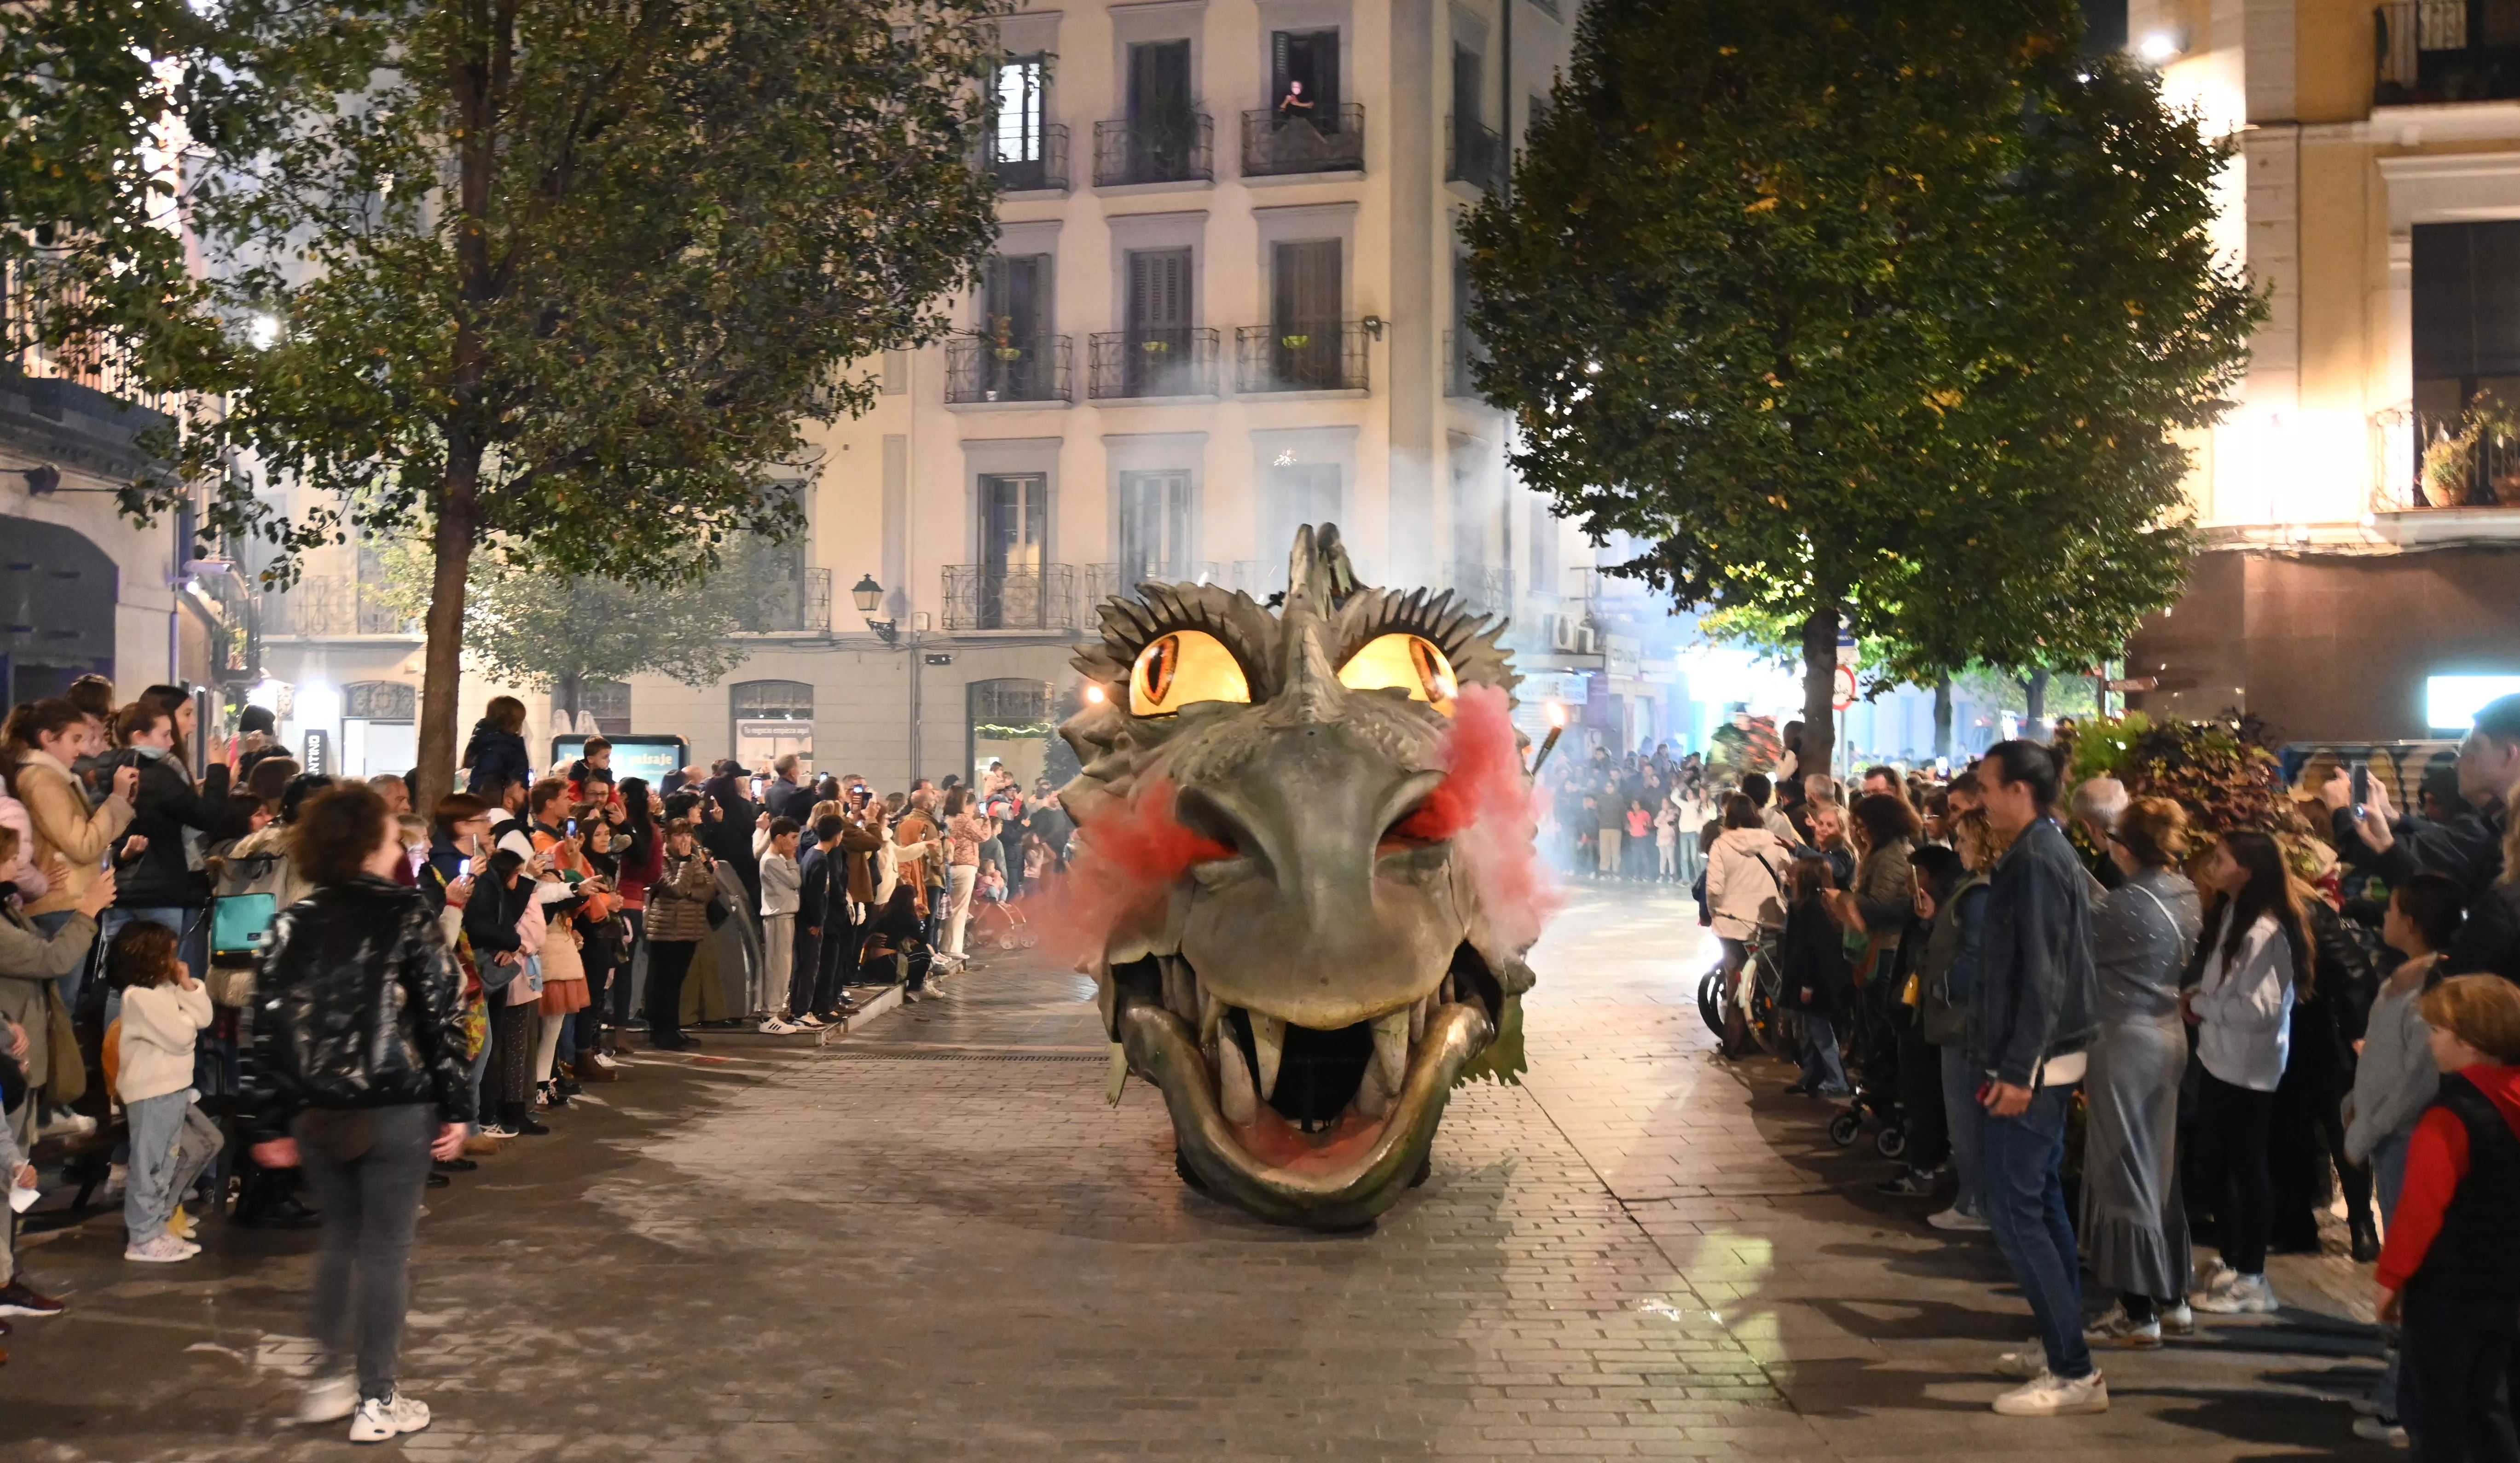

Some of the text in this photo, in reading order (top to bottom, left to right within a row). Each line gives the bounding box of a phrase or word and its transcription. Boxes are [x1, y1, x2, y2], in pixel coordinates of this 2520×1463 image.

[751, 726, 772, 735] negocio
[773, 726, 796, 735] empieza
[628, 753, 673, 766] paisaje
